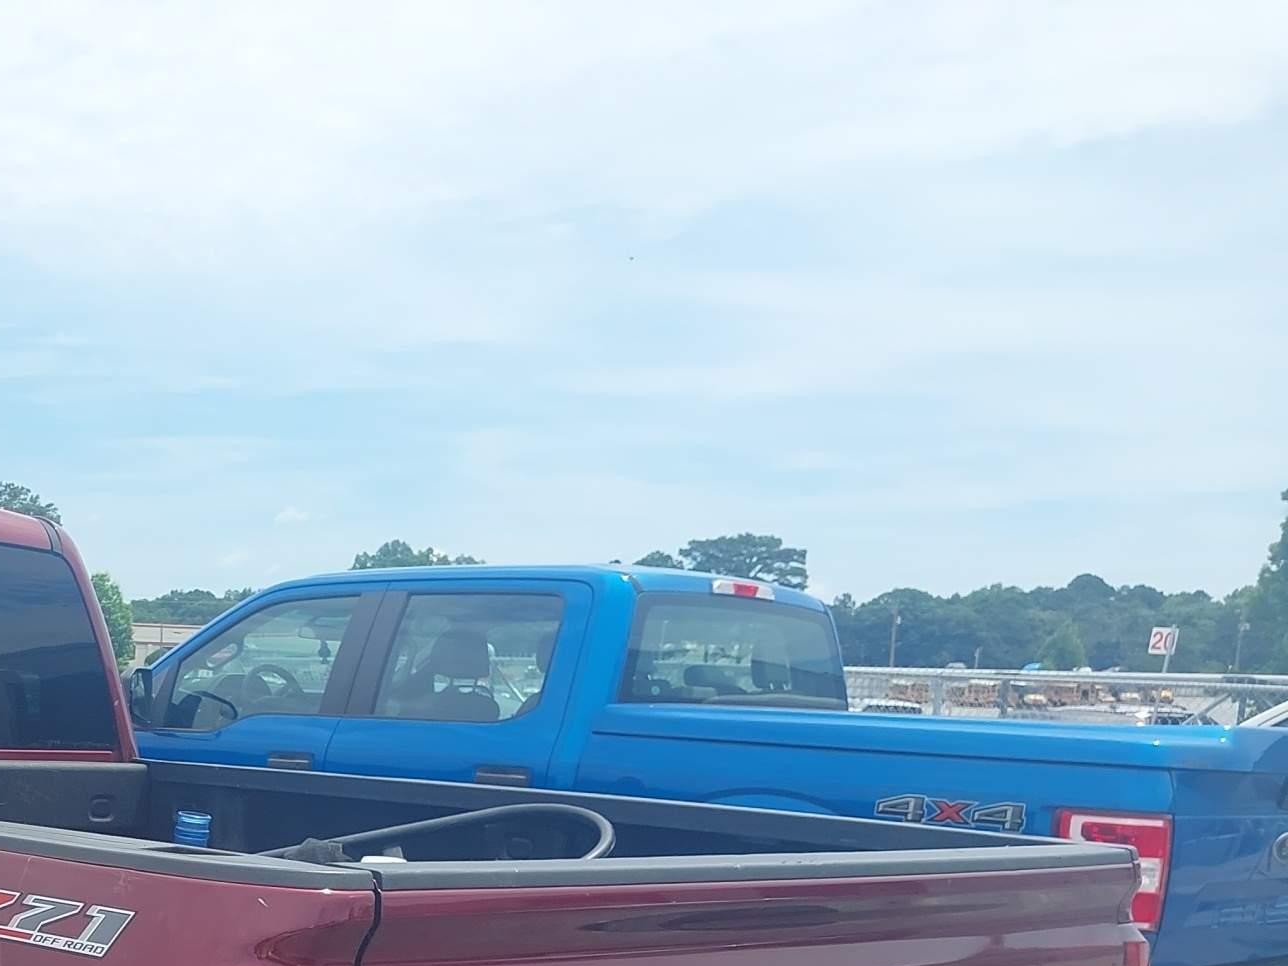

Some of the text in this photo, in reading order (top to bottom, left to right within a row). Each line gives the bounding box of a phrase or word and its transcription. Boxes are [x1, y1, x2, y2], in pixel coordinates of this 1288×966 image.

[1151, 631, 1176, 651] 20
[32, 934, 105, 955] OFF ROAD
